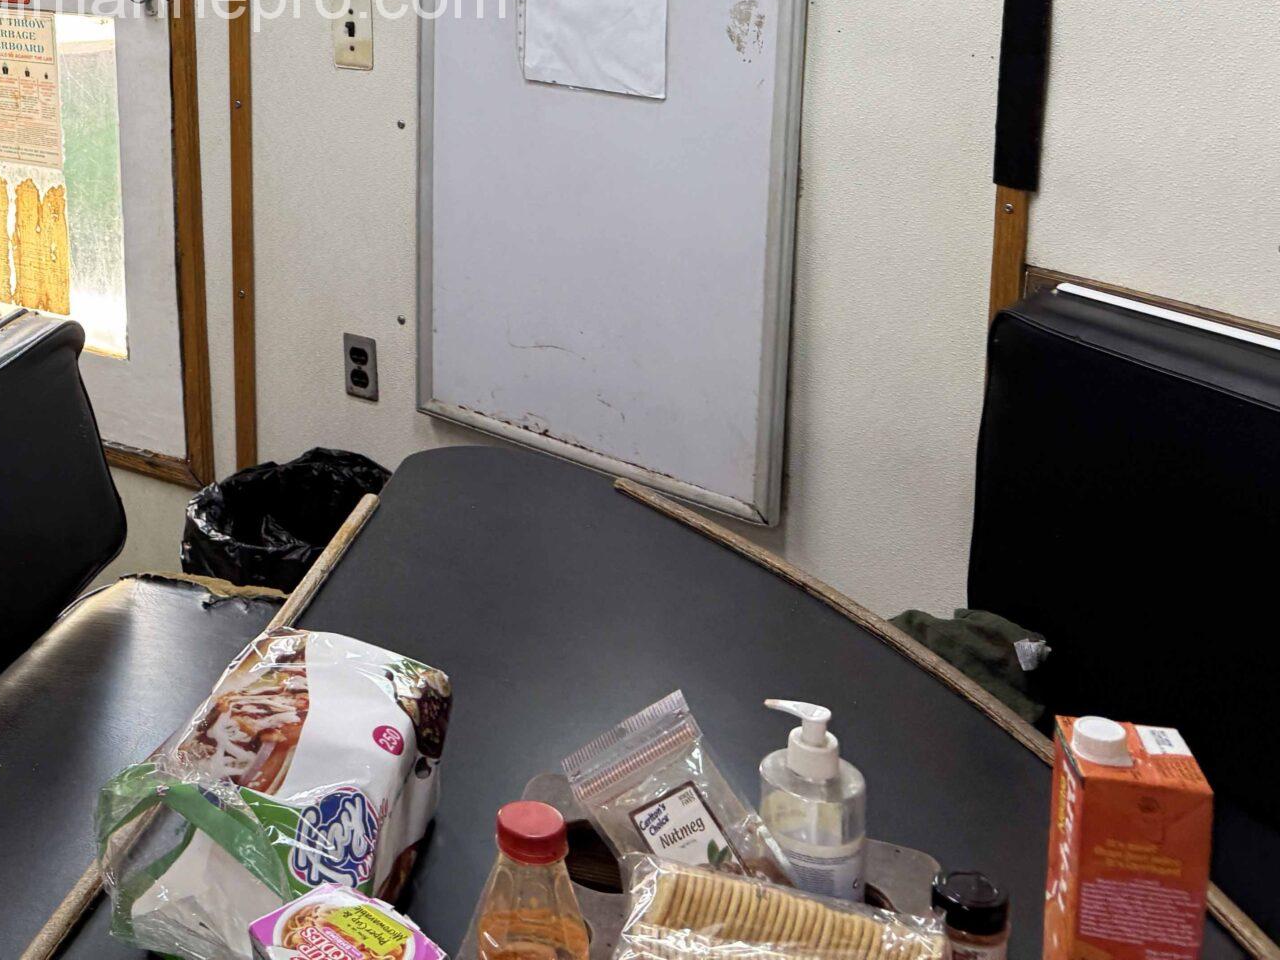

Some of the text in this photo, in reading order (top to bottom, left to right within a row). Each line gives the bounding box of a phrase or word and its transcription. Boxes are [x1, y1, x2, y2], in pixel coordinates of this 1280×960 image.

[6, 17, 45, 29] THROW
[378, 728, 401, 751] 250
[649, 815, 670, 836] Choice
[659, 817, 706, 849] Nutmeg
[351, 917, 368, 930] Cup
[354, 906, 408, 942] Microwavable
[302, 926, 350, 960] ODLES
[368, 928, 390, 946] Paper
